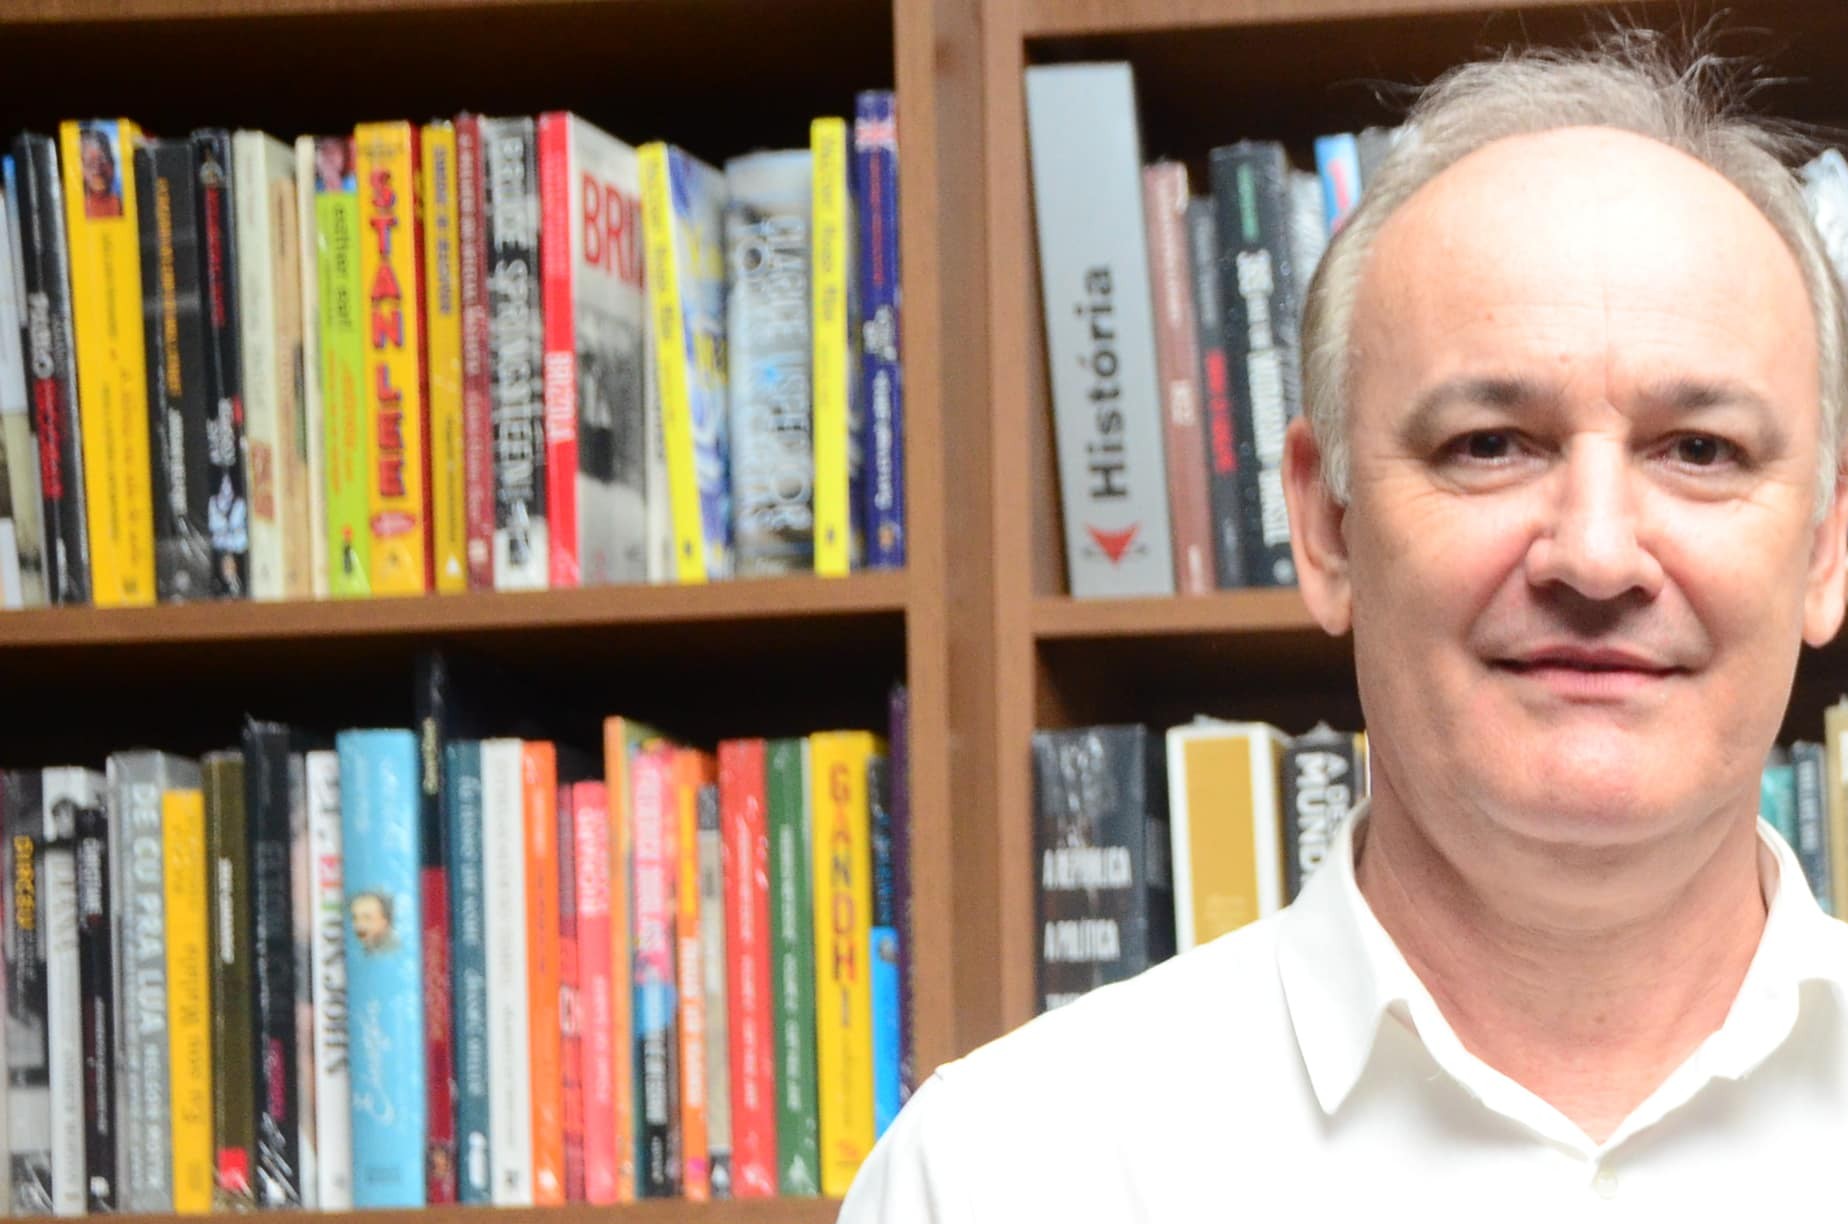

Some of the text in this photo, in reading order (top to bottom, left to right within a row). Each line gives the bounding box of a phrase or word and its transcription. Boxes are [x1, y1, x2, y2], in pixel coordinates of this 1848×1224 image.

[29, 292, 53, 378] PABLO
[371, 169, 407, 498] STAN LEE
[496, 137, 535, 488] BRUCE SPRINGSTEEN
[549, 350, 574, 444] BRIZOLA
[767, 215, 811, 531] CLARICE LISPECTOR
[1076, 266, 1128, 501] História
[14, 836, 36, 930] DIRCEU
[131, 782, 164, 1192] DE CU PRA LUA NELSON MOTTA
[829, 761, 856, 1030] GANDHI
